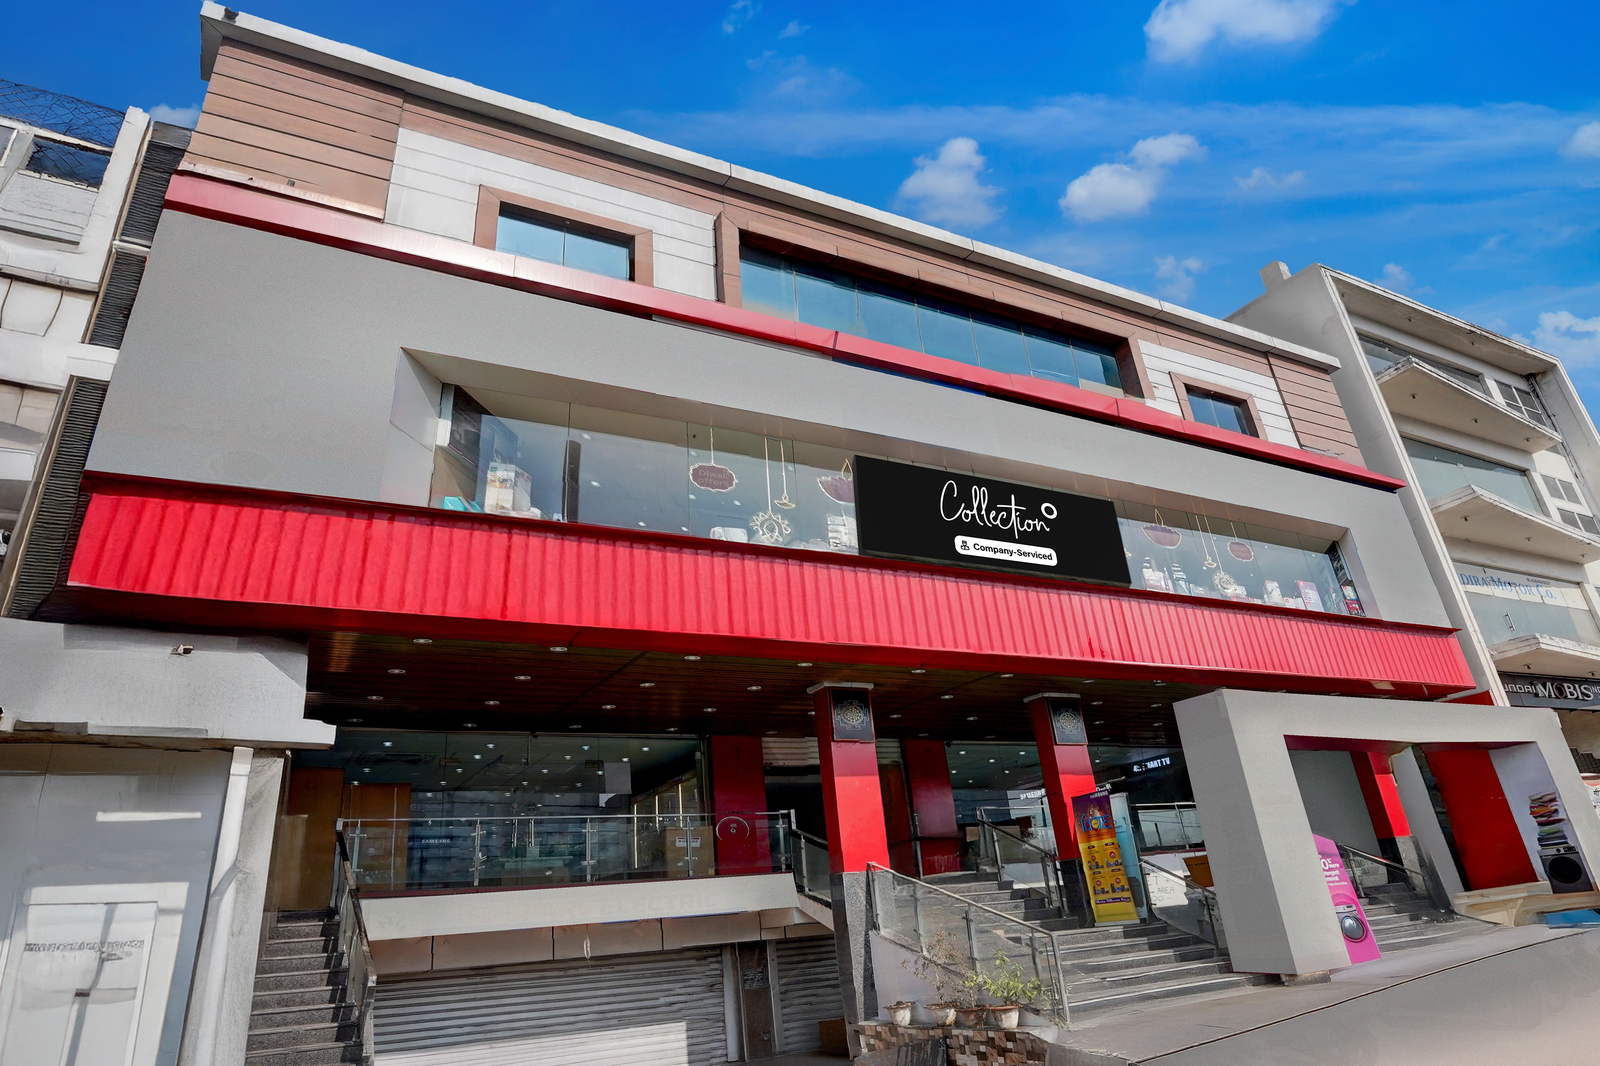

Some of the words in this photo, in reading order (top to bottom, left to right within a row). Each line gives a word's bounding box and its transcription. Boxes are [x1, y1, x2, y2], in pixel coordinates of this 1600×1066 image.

[940, 480, 1051, 540] Collection
[973, 543, 1053, 561] Company-Serviced
[1536, 681, 1594, 700] MOBIS
[1161, 757, 1170, 766] TV
